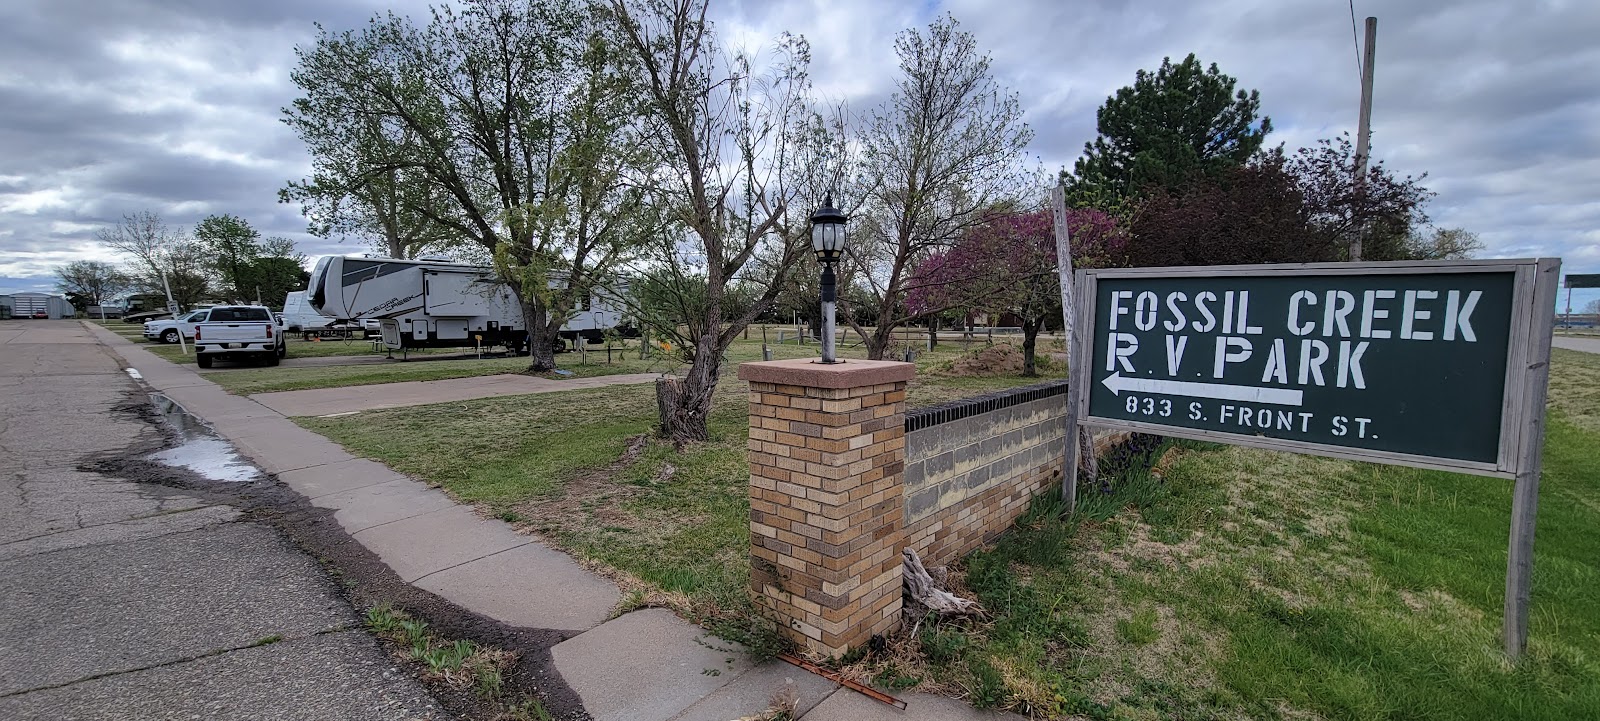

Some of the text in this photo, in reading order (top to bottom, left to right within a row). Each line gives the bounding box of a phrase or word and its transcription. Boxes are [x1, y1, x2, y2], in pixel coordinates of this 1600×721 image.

[367, 297, 399, 315] CEDAR
[1109, 290, 1483, 342] FOSSIL CREEK
[1125, 396, 1378, 439] 833 S. FRONT ST.
